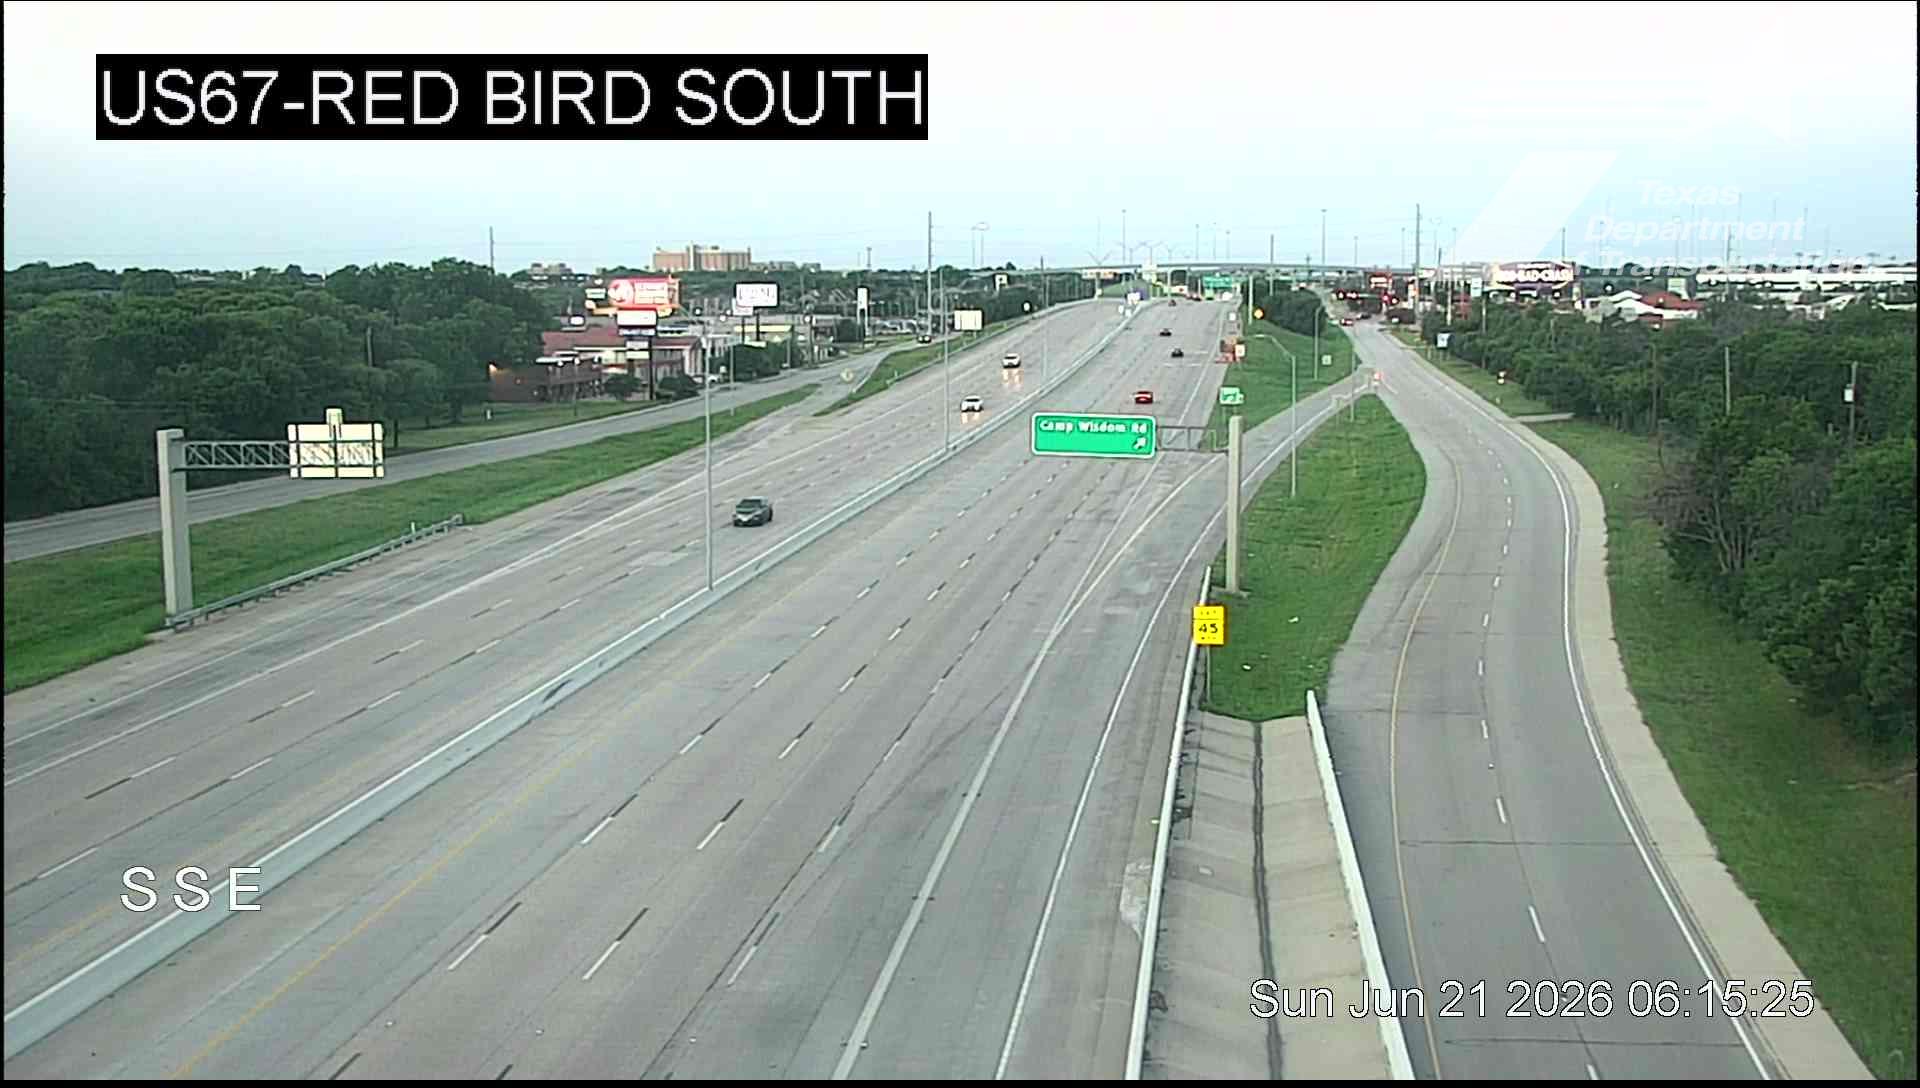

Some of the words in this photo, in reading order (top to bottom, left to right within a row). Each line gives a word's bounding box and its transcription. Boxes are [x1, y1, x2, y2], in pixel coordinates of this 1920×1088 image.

[1040, 420, 1073, 434] Camp
[1078, 421, 1127, 433] Wisdom
[1131, 423, 1147, 434] Rd
[1198, 622, 1218, 634] 45
